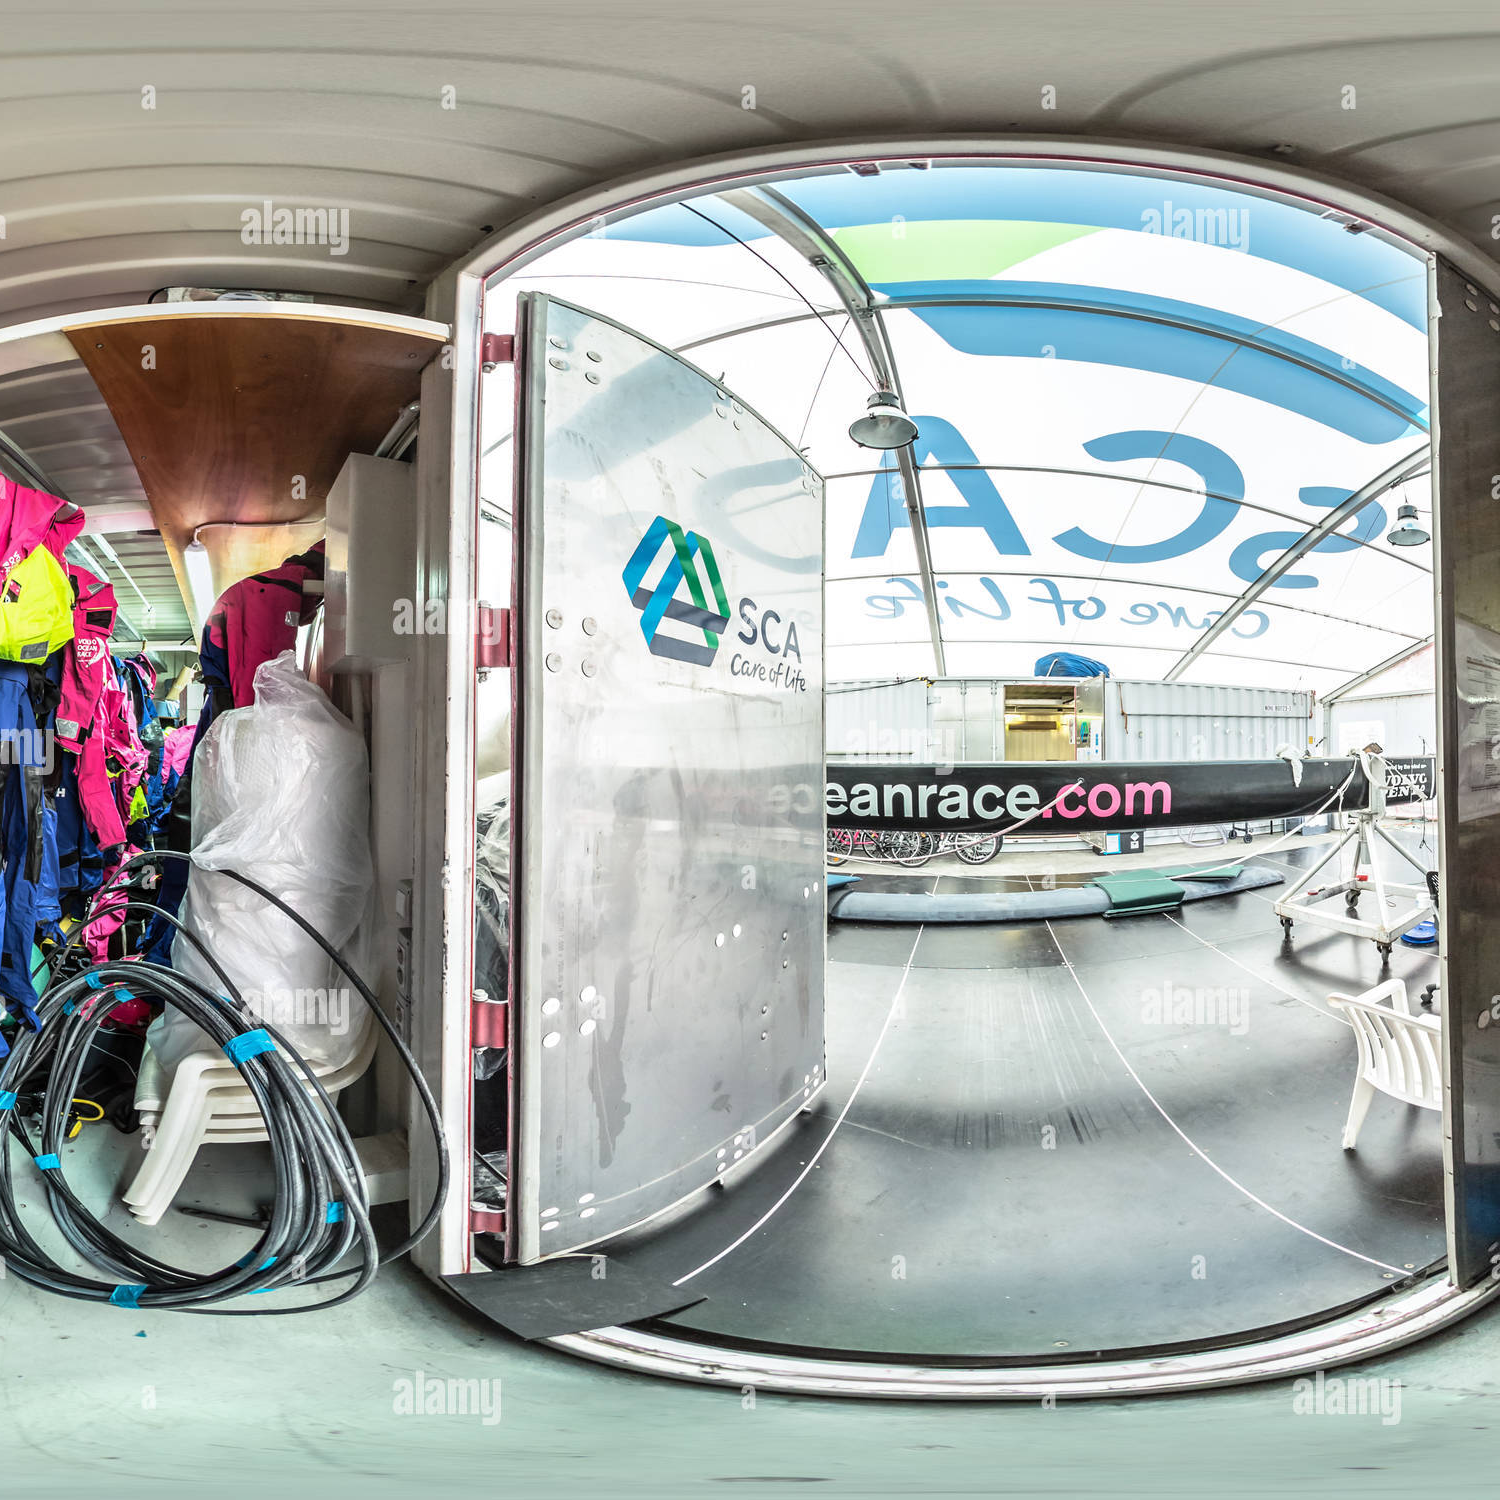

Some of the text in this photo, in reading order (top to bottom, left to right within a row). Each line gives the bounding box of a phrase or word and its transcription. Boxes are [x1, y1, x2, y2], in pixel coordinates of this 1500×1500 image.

[738, 597, 802, 664] SCA
[731, 653, 806, 693] Care of life
